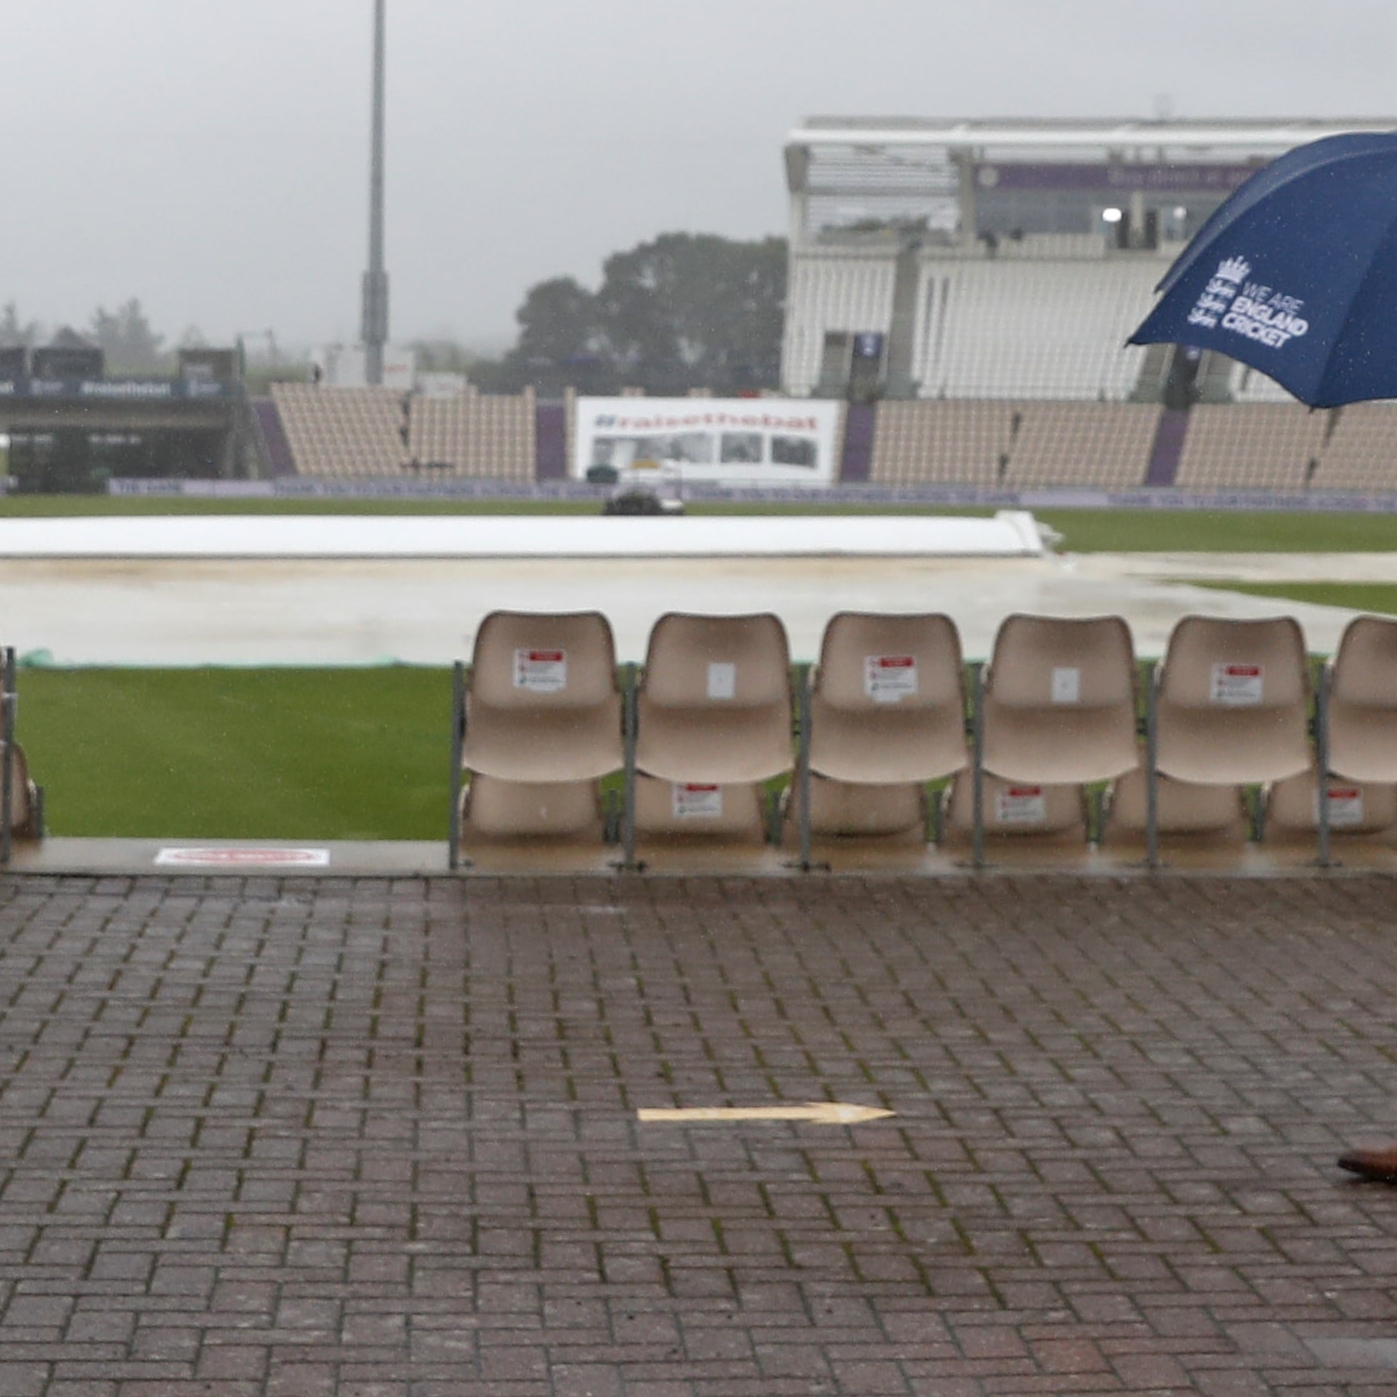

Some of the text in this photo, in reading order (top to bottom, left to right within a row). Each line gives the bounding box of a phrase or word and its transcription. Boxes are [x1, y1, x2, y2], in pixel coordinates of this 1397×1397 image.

[1242, 281, 1305, 315] WE ARE
[1221, 312, 1291, 349] CRICKET
[1230, 296, 1309, 336] ENGLAND
[594, 412, 818, 431] #raisethebat
